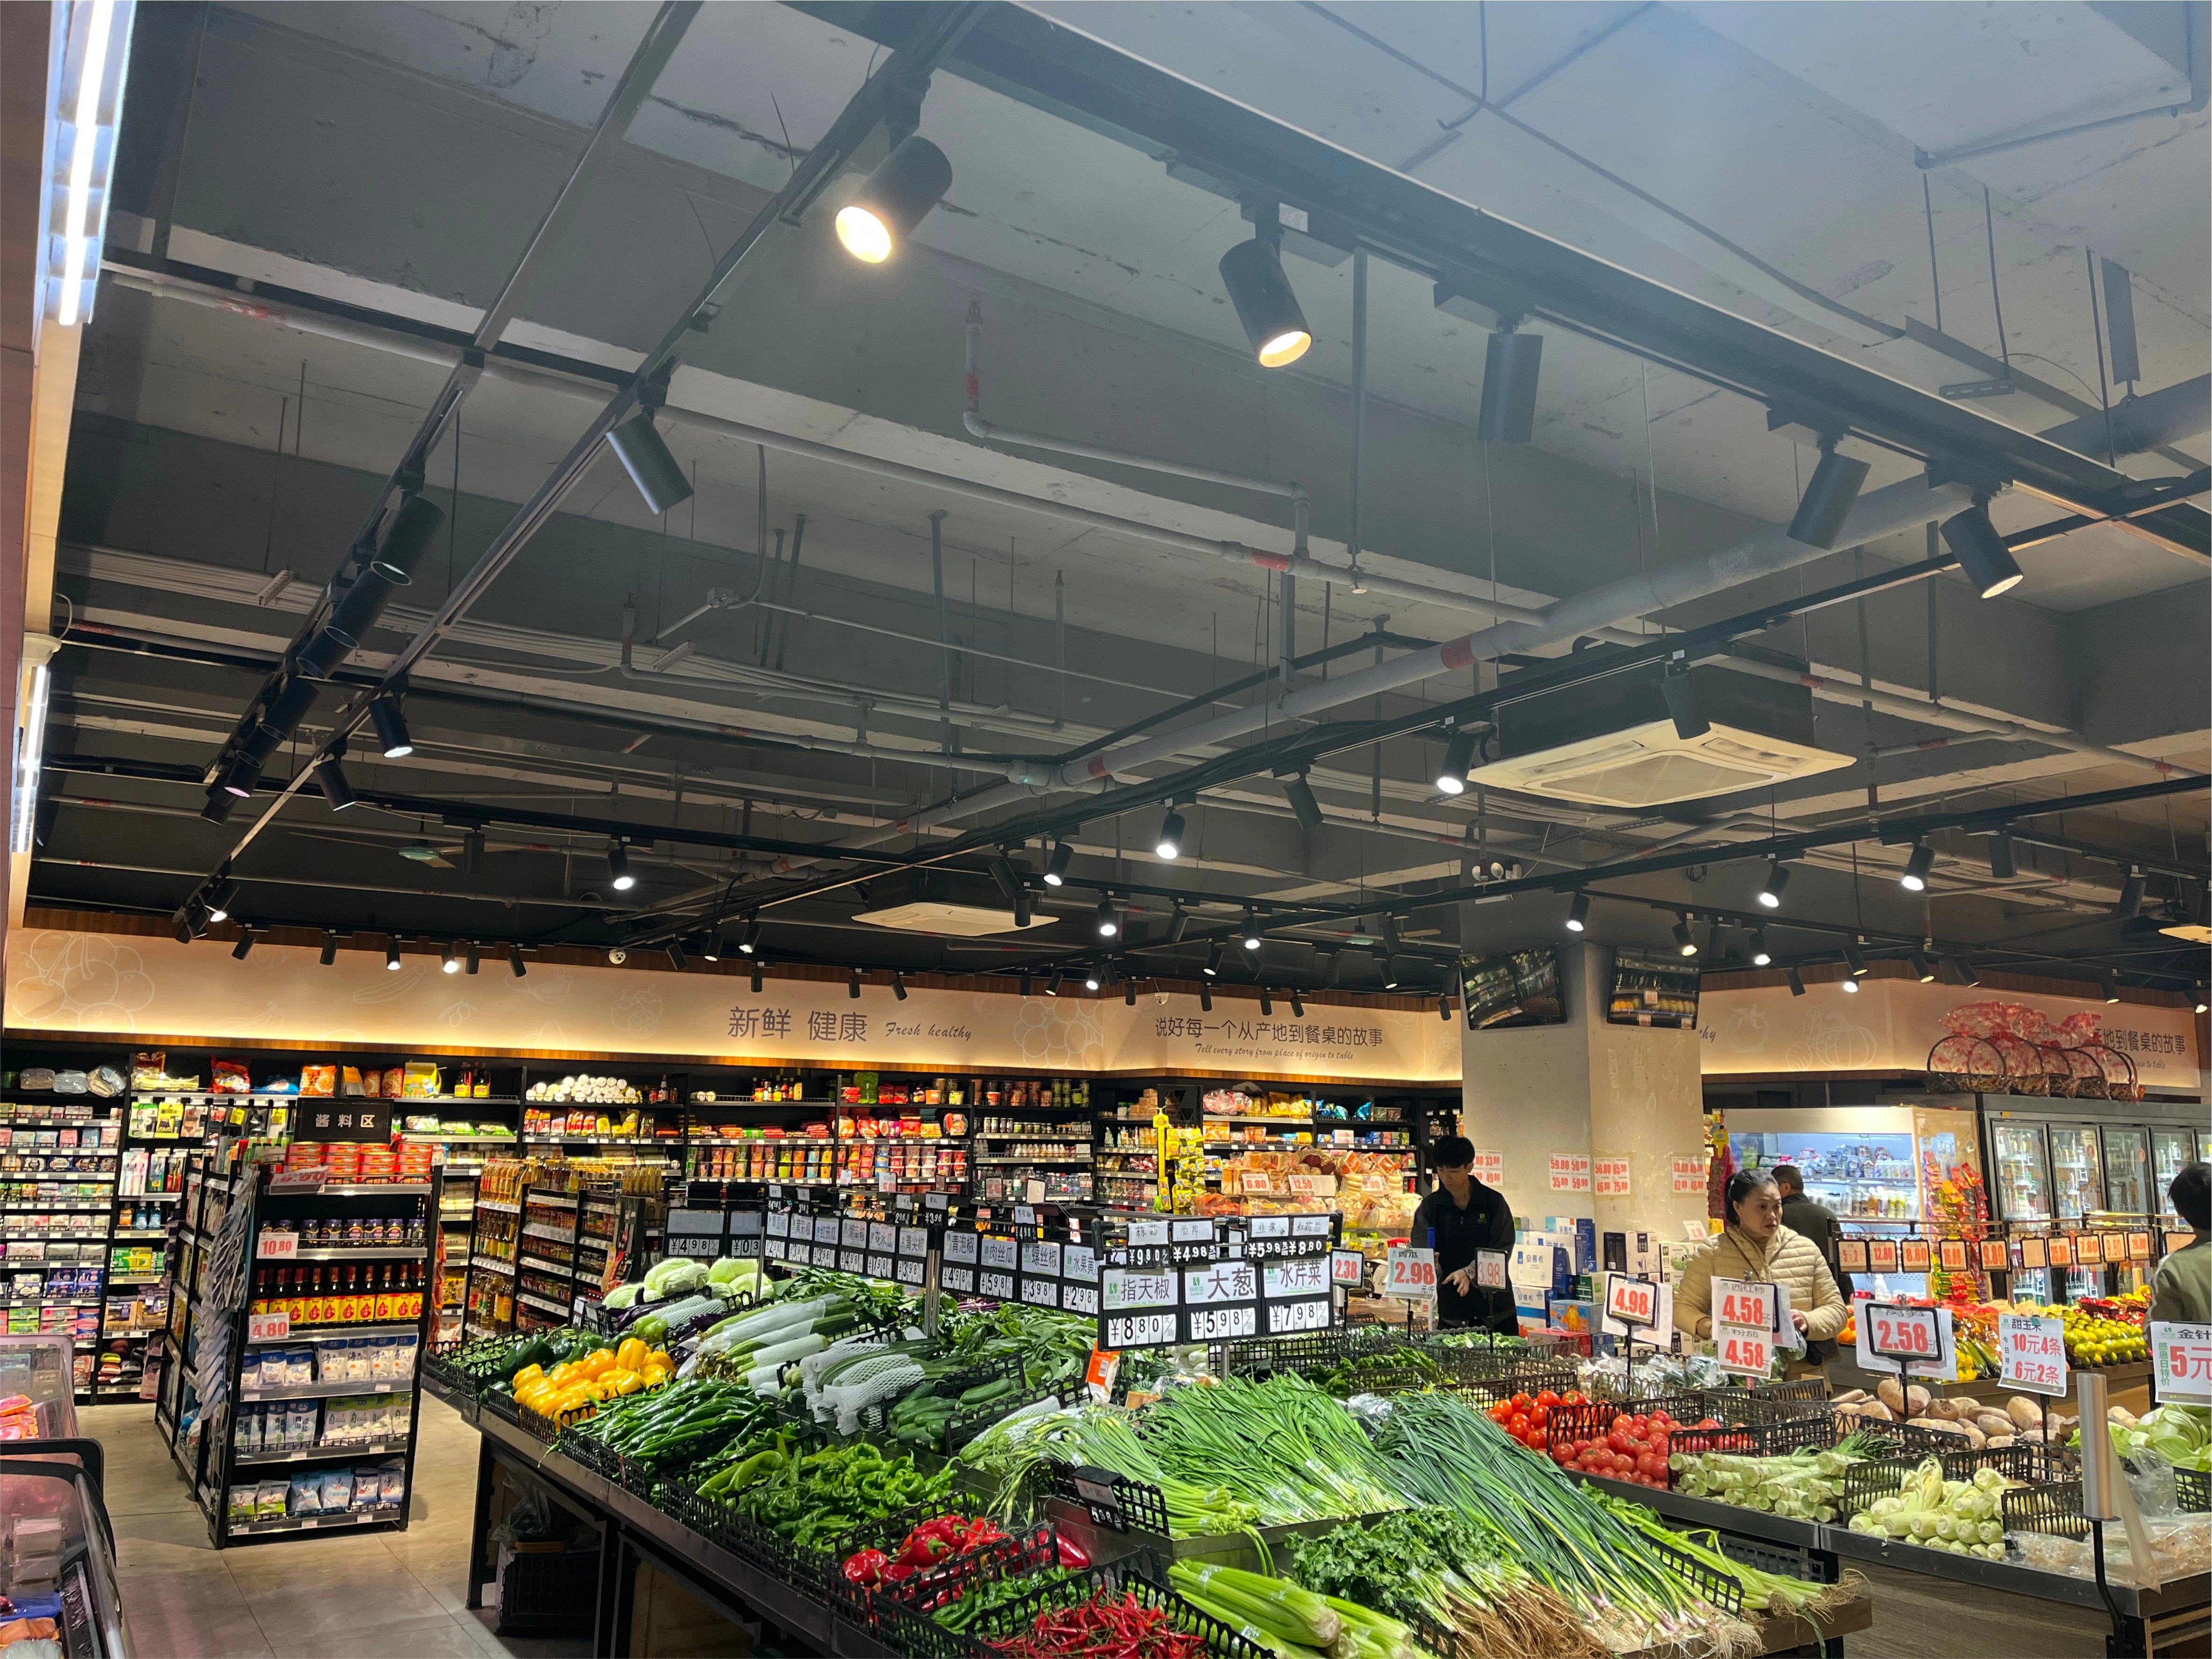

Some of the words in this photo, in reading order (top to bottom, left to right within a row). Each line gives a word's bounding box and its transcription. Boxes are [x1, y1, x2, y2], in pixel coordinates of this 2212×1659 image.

[728, 1006, 791, 1039] 新鲜
[808, 1010, 867, 1042] 健康
[885, 1022, 921, 1037] Fresh
[928, 1023, 972, 1042] healthy
[1155, 1017, 1383, 1047] 说好每一个从产地到餐桌的故事
[1195, 1043, 1212, 1053] Tell
[1213, 1045, 1233, 1056] every
[1235, 1047, 1253, 1057] story
[1255, 1046, 1273, 1058] from
[1274, 1048, 1294, 1058] place
[1295, 1050, 1303, 1060] of
[1304, 1050, 1326, 1060] origin
[1336, 1051, 1354, 1060] table
[315, 1114, 375, 1128] 酱料区
[1246, 1179, 1267, 1189] 6.80
[1293, 1179, 1312, 1189] 12.50
[263, 1240, 292, 1255] 10.80
[671, 1239, 707, 1252] ¥4.98
[875, 1230, 892, 1248] 花水瓜
[906, 1234, 925, 1253] 青尖椒
[952, 1234, 975, 1254] 青泡椒
[1288, 1241, 1322, 1255] ¥8.80
[2080, 1241, 2098, 1254] 7.80
[2107, 1239, 2122, 1257] 9.80
[990, 1244, 1013, 1264] 肉丝瓜
[1031, 1246, 1057, 1268] 螺丝椒
[1129, 1248, 1160, 1265] ¥9.80
[1173, 1246, 1207, 1263] ¥4.98
[1249, 1242, 1281, 1258] ¥5.98
[1874, 1247, 1893, 1261] 12.80
[1906, 1248, 1927, 1263] 8.80
[1943, 1248, 1961, 1265] 16.80
[1982, 1244, 2004, 1265] 9.80
[1280, 1260, 1322, 1288] 水芹菜
[1335, 1259, 1358, 1280] 2.38
[1394, 1262, 1435, 1285] 2.98
[1478, 1261, 1501, 1286] 3.98
[1121, 1277, 1169, 1301] 指天椒
[1207, 1267, 1255, 1300] 大葱
[1615, 1288, 1648, 1316] 4.98
[1722, 1295, 1763, 1325] 4.58
[1194, 1311, 1240, 1335] ¥5.98
[1273, 1304, 1315, 1328] ¥7.98
[252, 1321, 288, 1337] 4.80
[1111, 1317, 1159, 1341] ¥8.80
[1877, 1320, 1928, 1352] 2.58
[1725, 1339, 1764, 1369] 4.58
[2011, 1333, 2062, 1357] 10元4条
[2014, 1361, 2059, 1385] 6元2条
[2158, 1343, 2170, 1387] 感恩日特价
